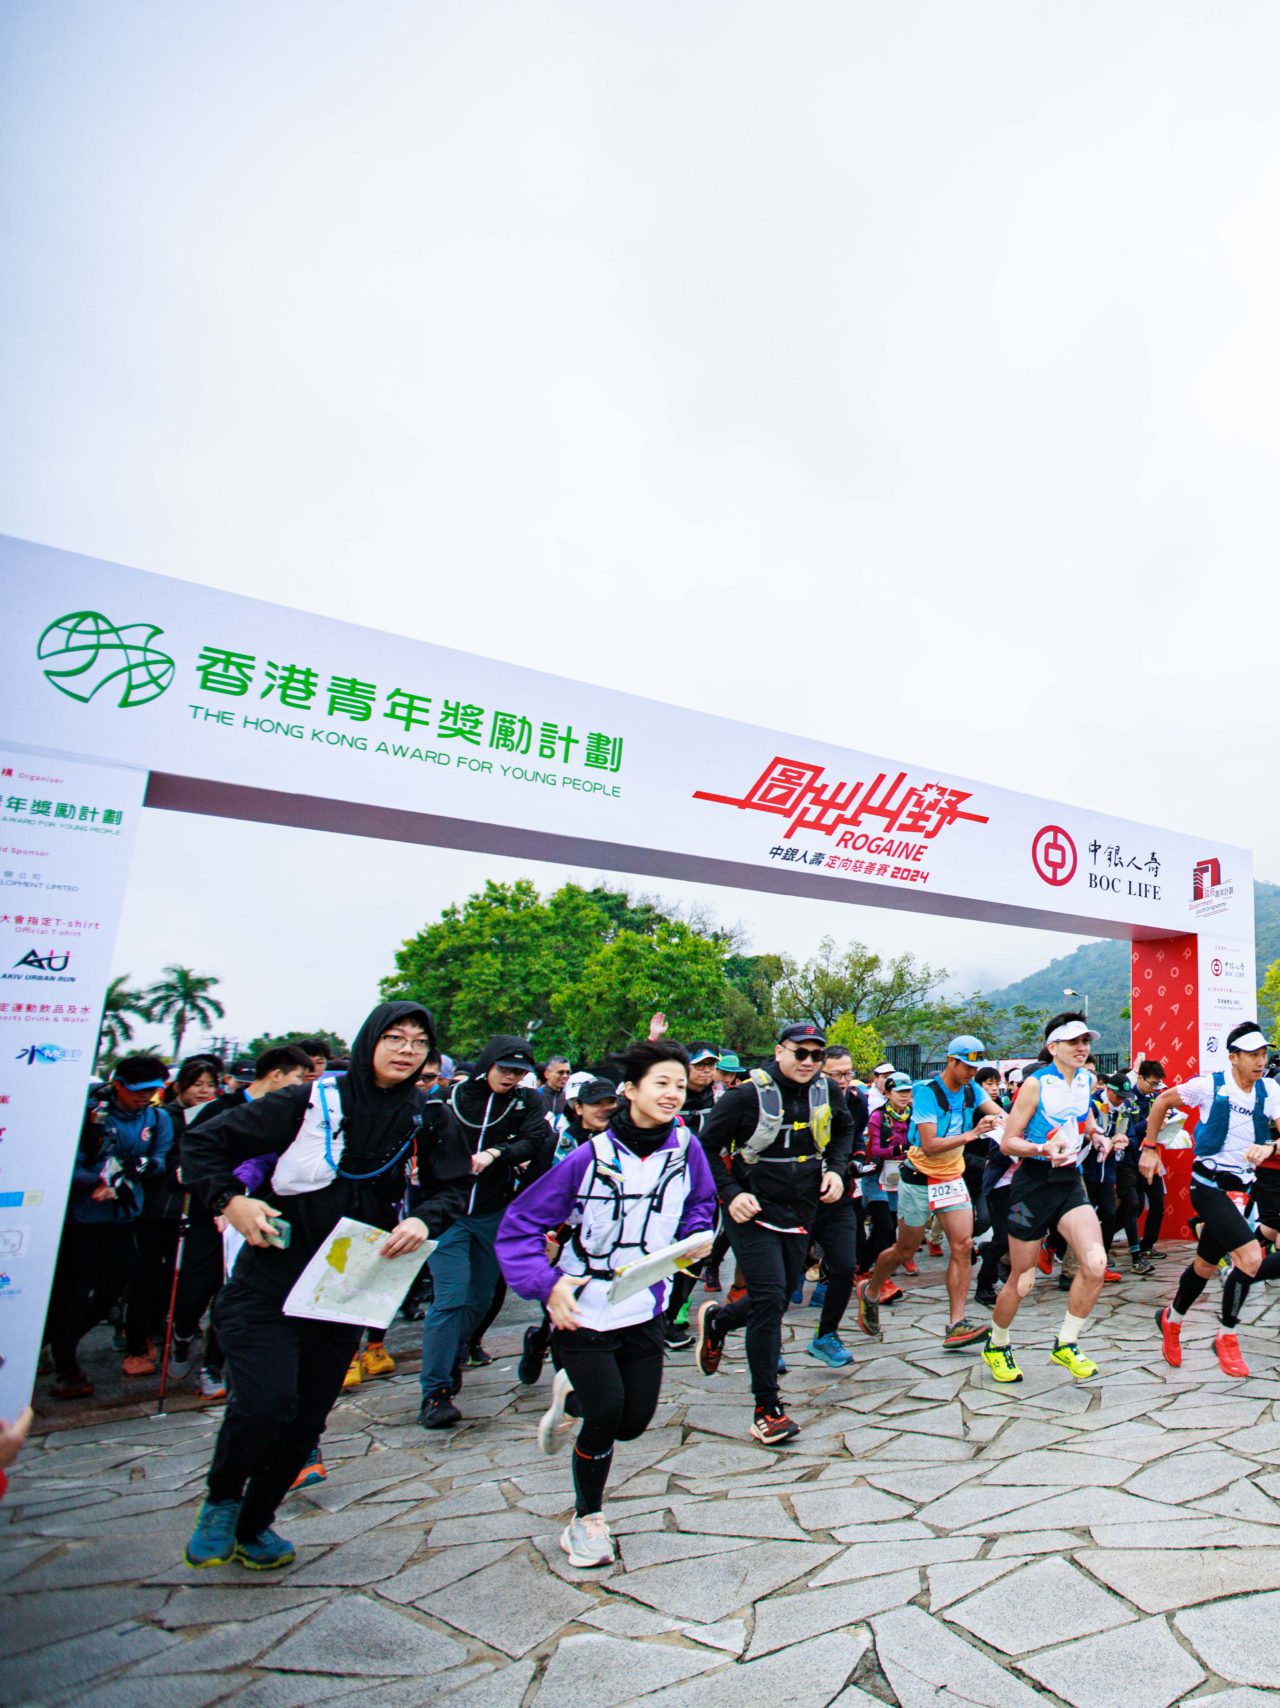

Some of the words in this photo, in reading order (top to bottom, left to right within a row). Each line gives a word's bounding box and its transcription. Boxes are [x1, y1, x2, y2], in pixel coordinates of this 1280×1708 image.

[196, 646, 624, 773] 香港青年獎勵計劃
[188, 704, 235, 726] THE
[243, 715, 305, 739] HONG
[311, 728, 368, 751] KONG
[374, 741, 451, 766] AWARD
[456, 757, 493, 774] FOR
[500, 764, 557, 786] YOUNG
[562, 776, 622, 798] PEOPLE
[18, 772, 64, 784] Organiser
[0, 795, 124, 826] 年獎勵計劃
[11, 847, 49, 858] Sponsor
[835, 830, 928, 863] ROGAINE
[1089, 839, 1161, 878] 中銀人壽
[890, 866, 930, 884] 2024
[1089, 873, 1121, 894] BOC
[1128, 880, 1161, 901] LIFE
